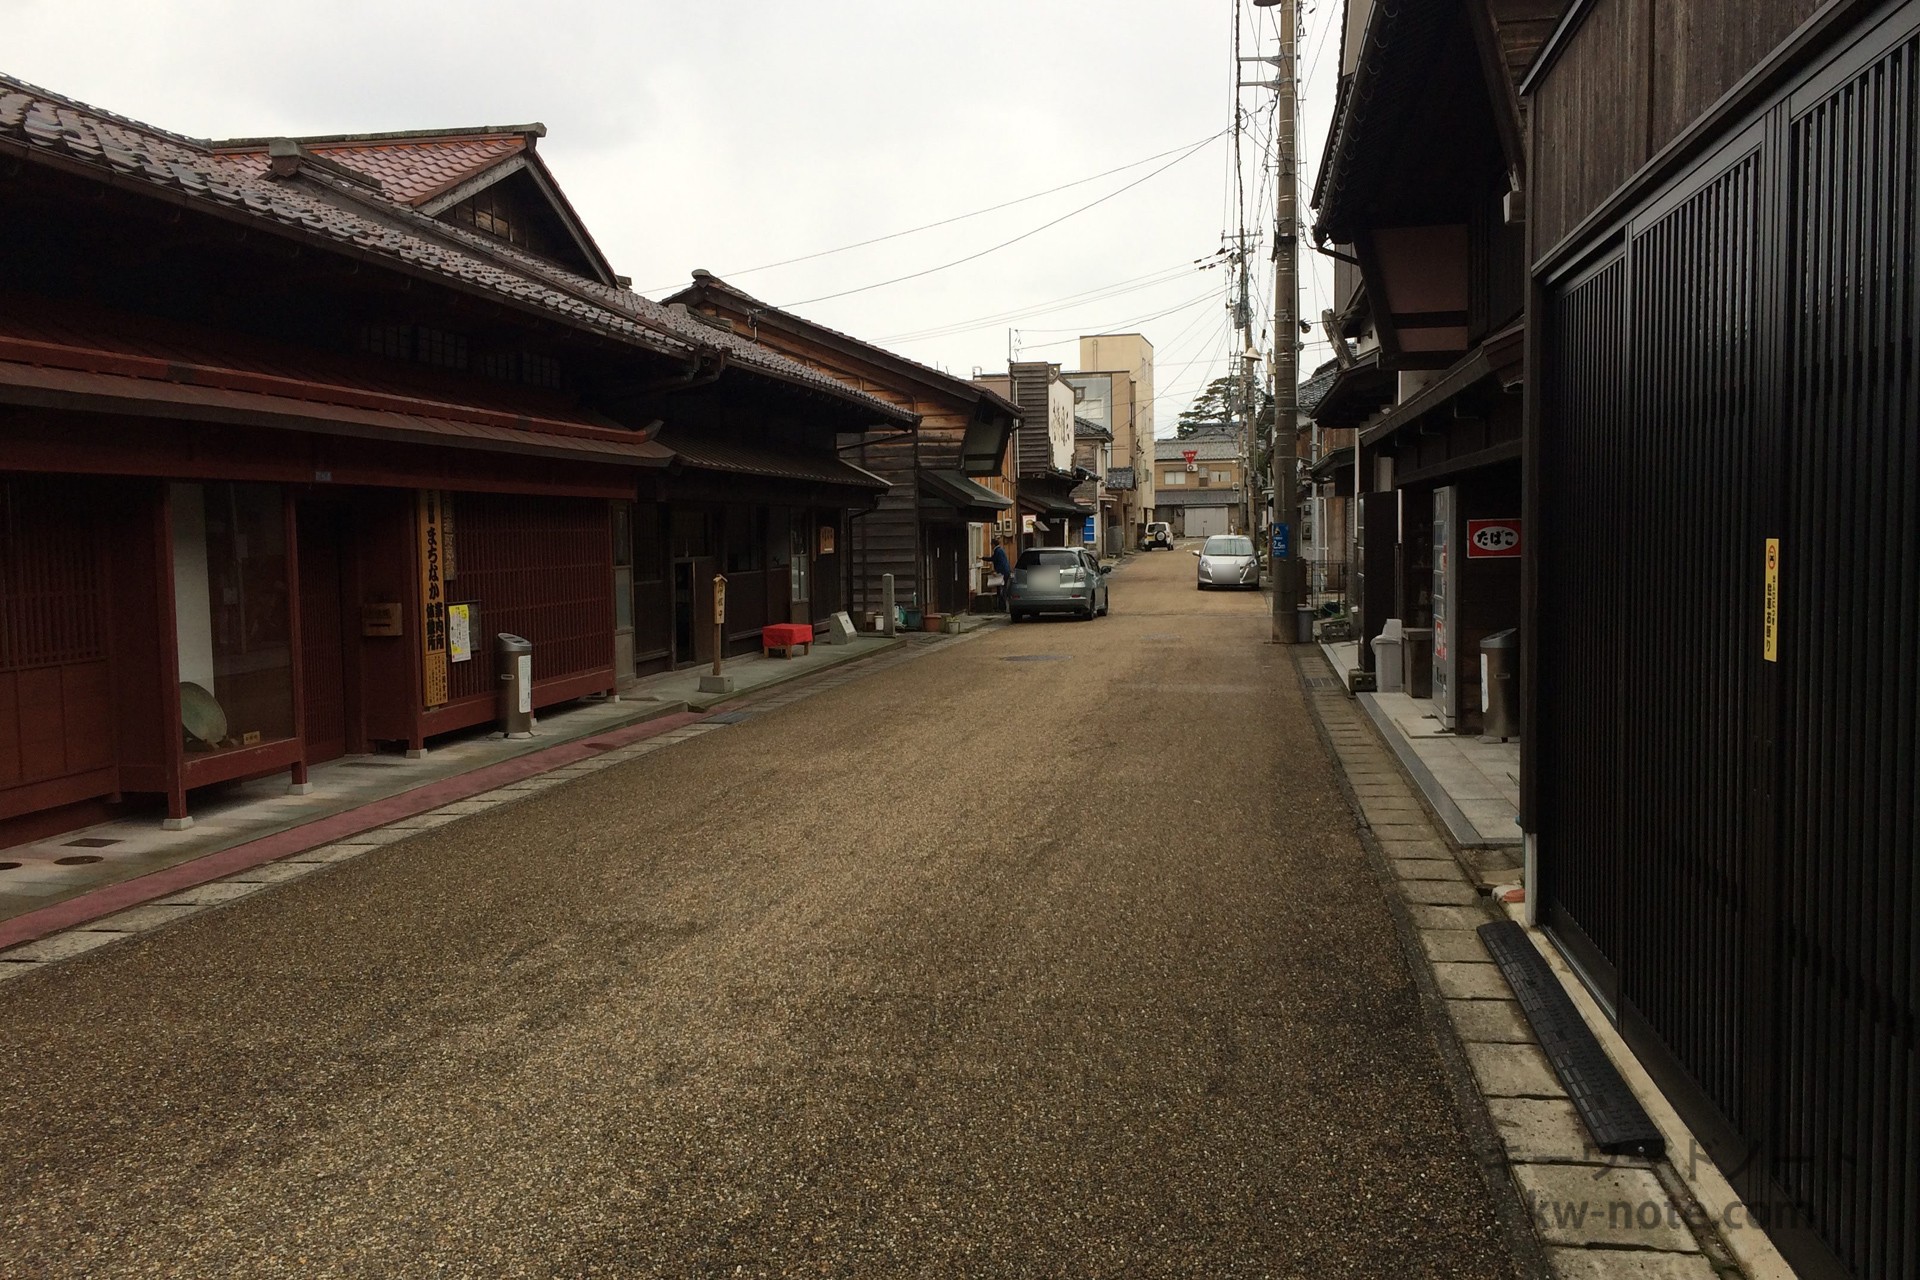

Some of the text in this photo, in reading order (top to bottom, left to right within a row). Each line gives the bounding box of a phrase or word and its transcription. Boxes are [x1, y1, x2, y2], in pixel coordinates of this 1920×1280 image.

[1477, 530, 1514, 546] たばこ
[427, 527, 440, 600] まちなか
[435, 601, 444, 650] 案内所
